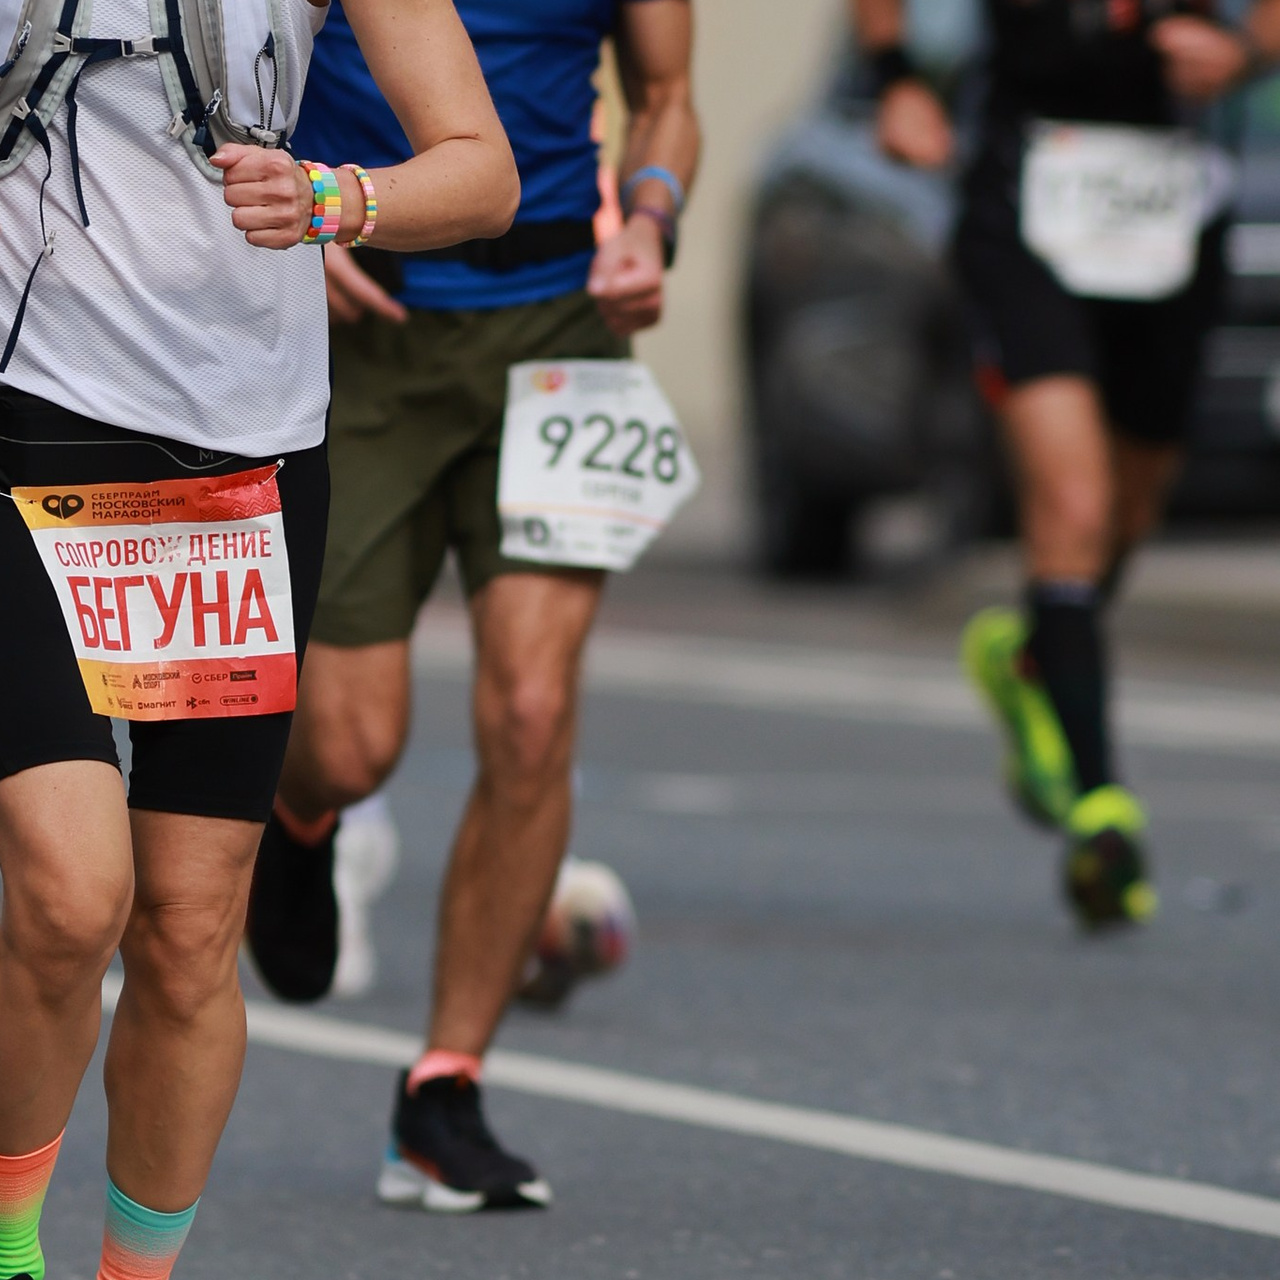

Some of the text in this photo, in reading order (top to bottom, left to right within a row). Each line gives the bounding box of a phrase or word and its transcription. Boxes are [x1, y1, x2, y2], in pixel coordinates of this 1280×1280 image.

[539, 413, 680, 484] 9228
[91, 490, 160, 500] СБЕРПРАЙМ
[91, 496, 185, 510] МОСКОВСКИЙ
[92, 508, 161, 519] МАРАФОН
[66, 569, 279, 651] БЕГУНА
[204, 673, 228, 682] СБЕР
